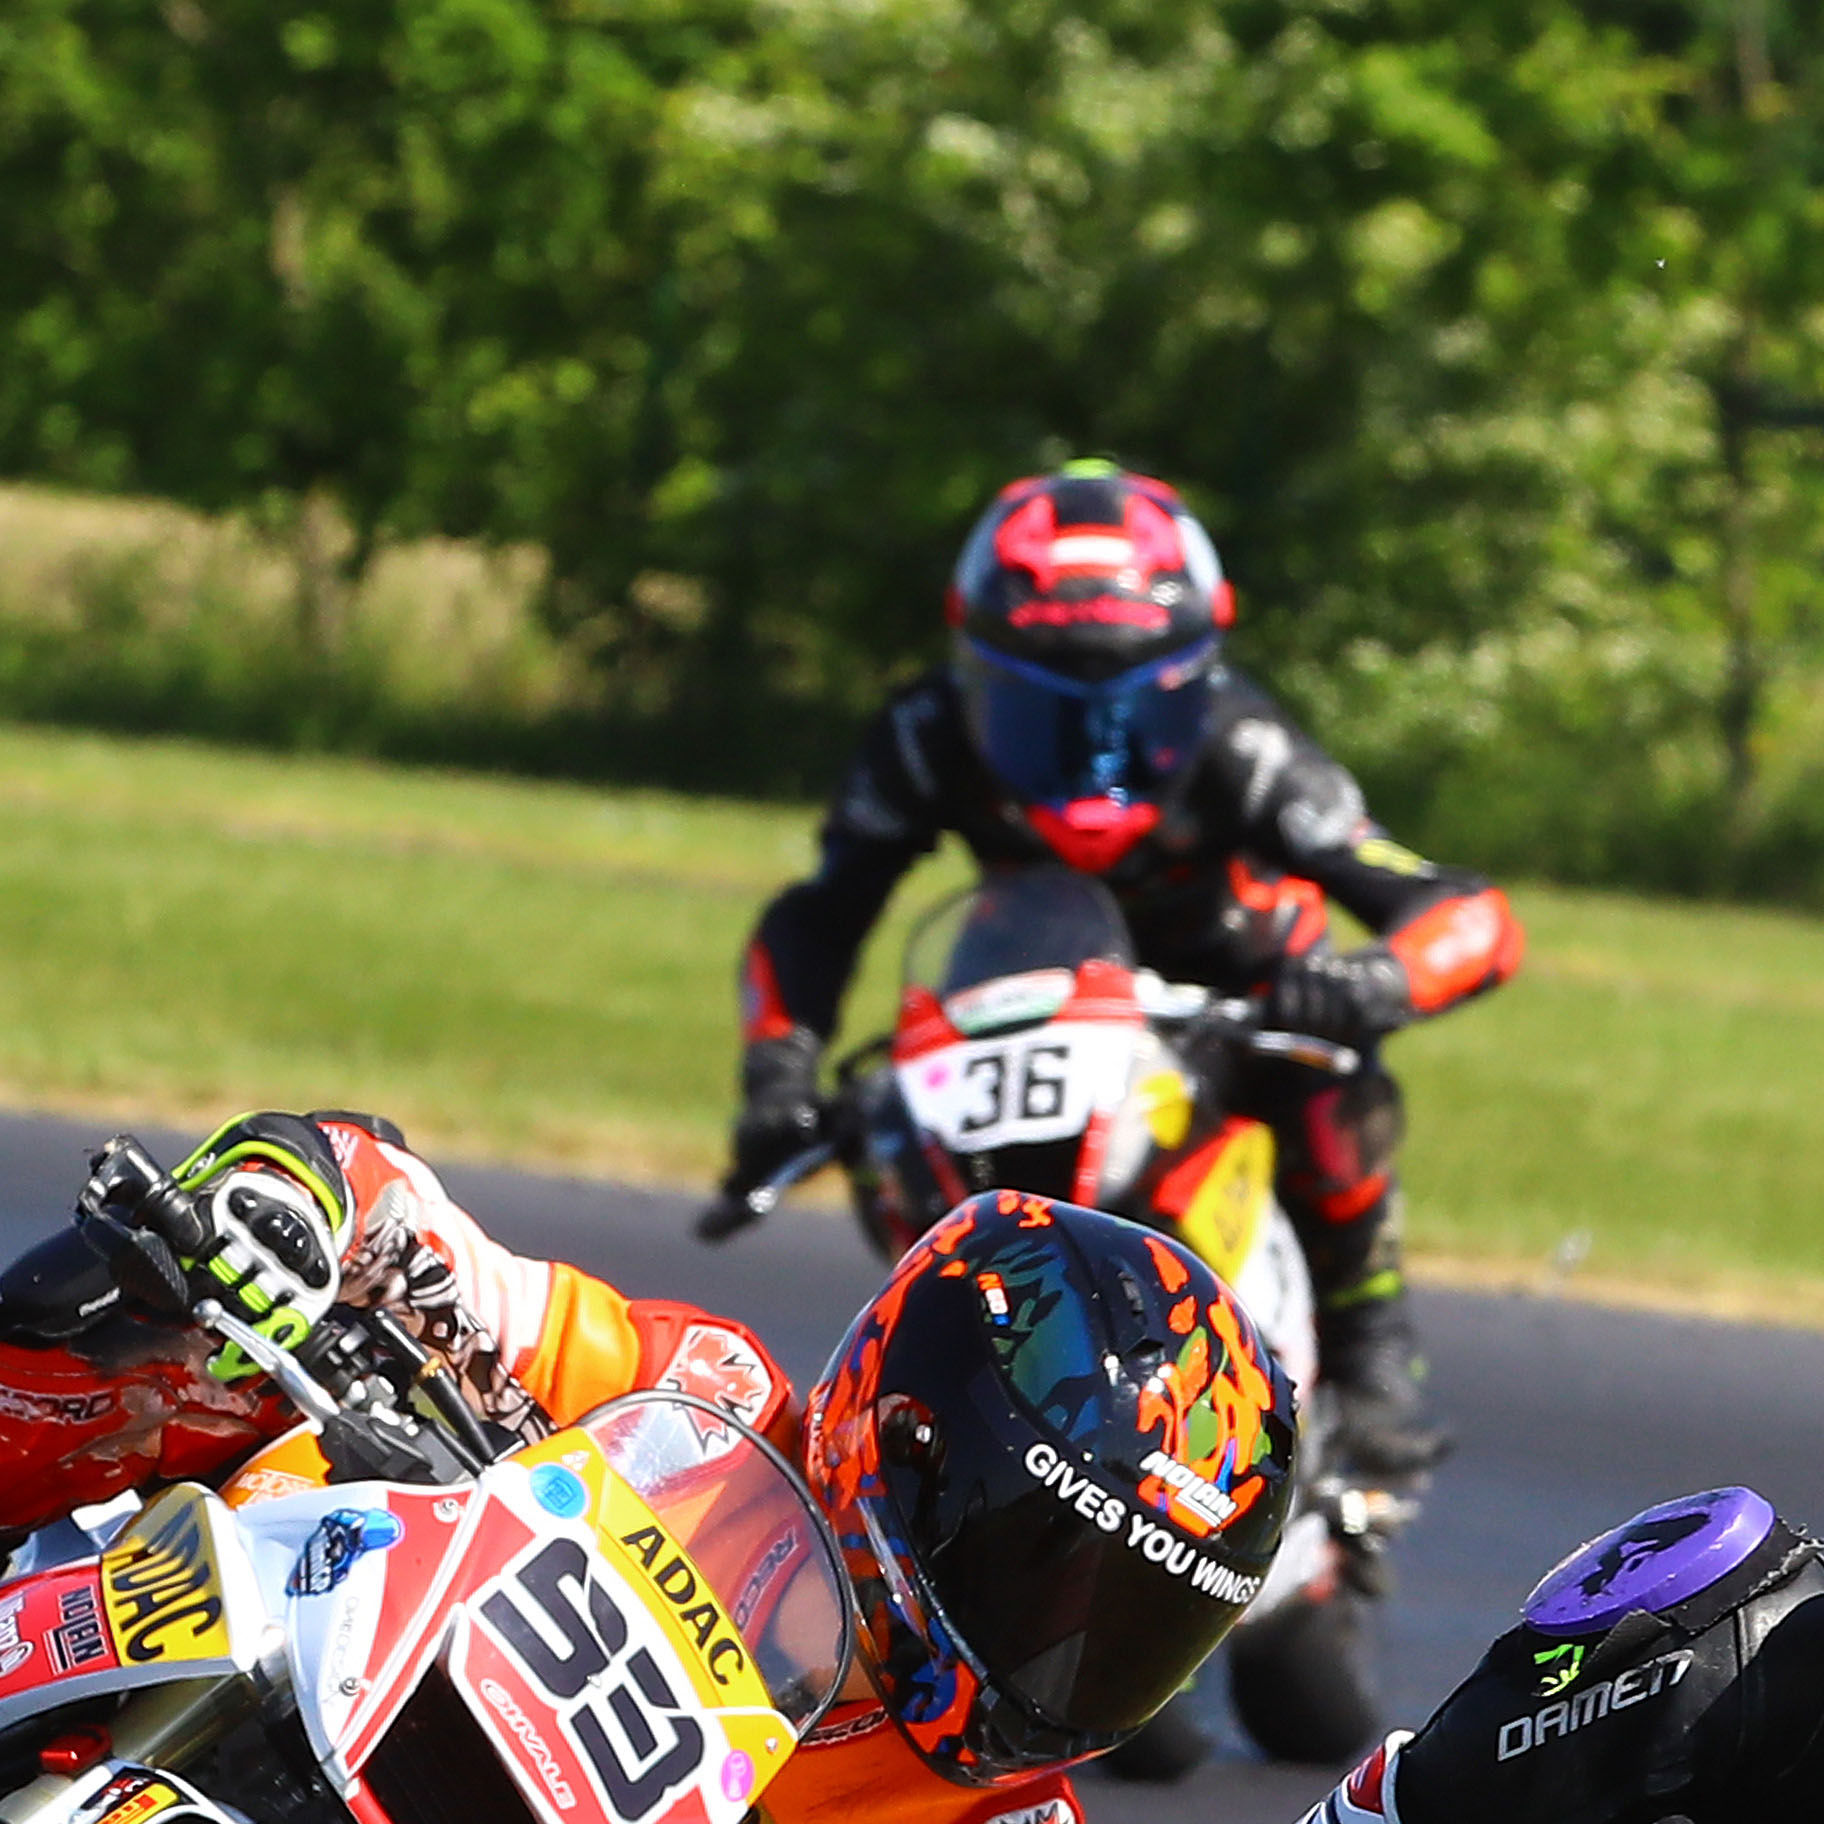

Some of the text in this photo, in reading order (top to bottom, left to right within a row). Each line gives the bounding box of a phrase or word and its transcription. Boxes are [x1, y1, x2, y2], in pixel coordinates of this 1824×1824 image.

[958, 1045, 1070, 1135] 36
[1024, 1442, 1261, 1606] GIVES YOU WINGS
[1139, 1449, 1238, 1525] NOLAN
[43, 1584, 108, 1676] NOLAN
[622, 1524, 745, 1686] ADAC
[479, 1536, 704, 1822] 53
[1497, 1649, 1694, 1764] DAMEN
